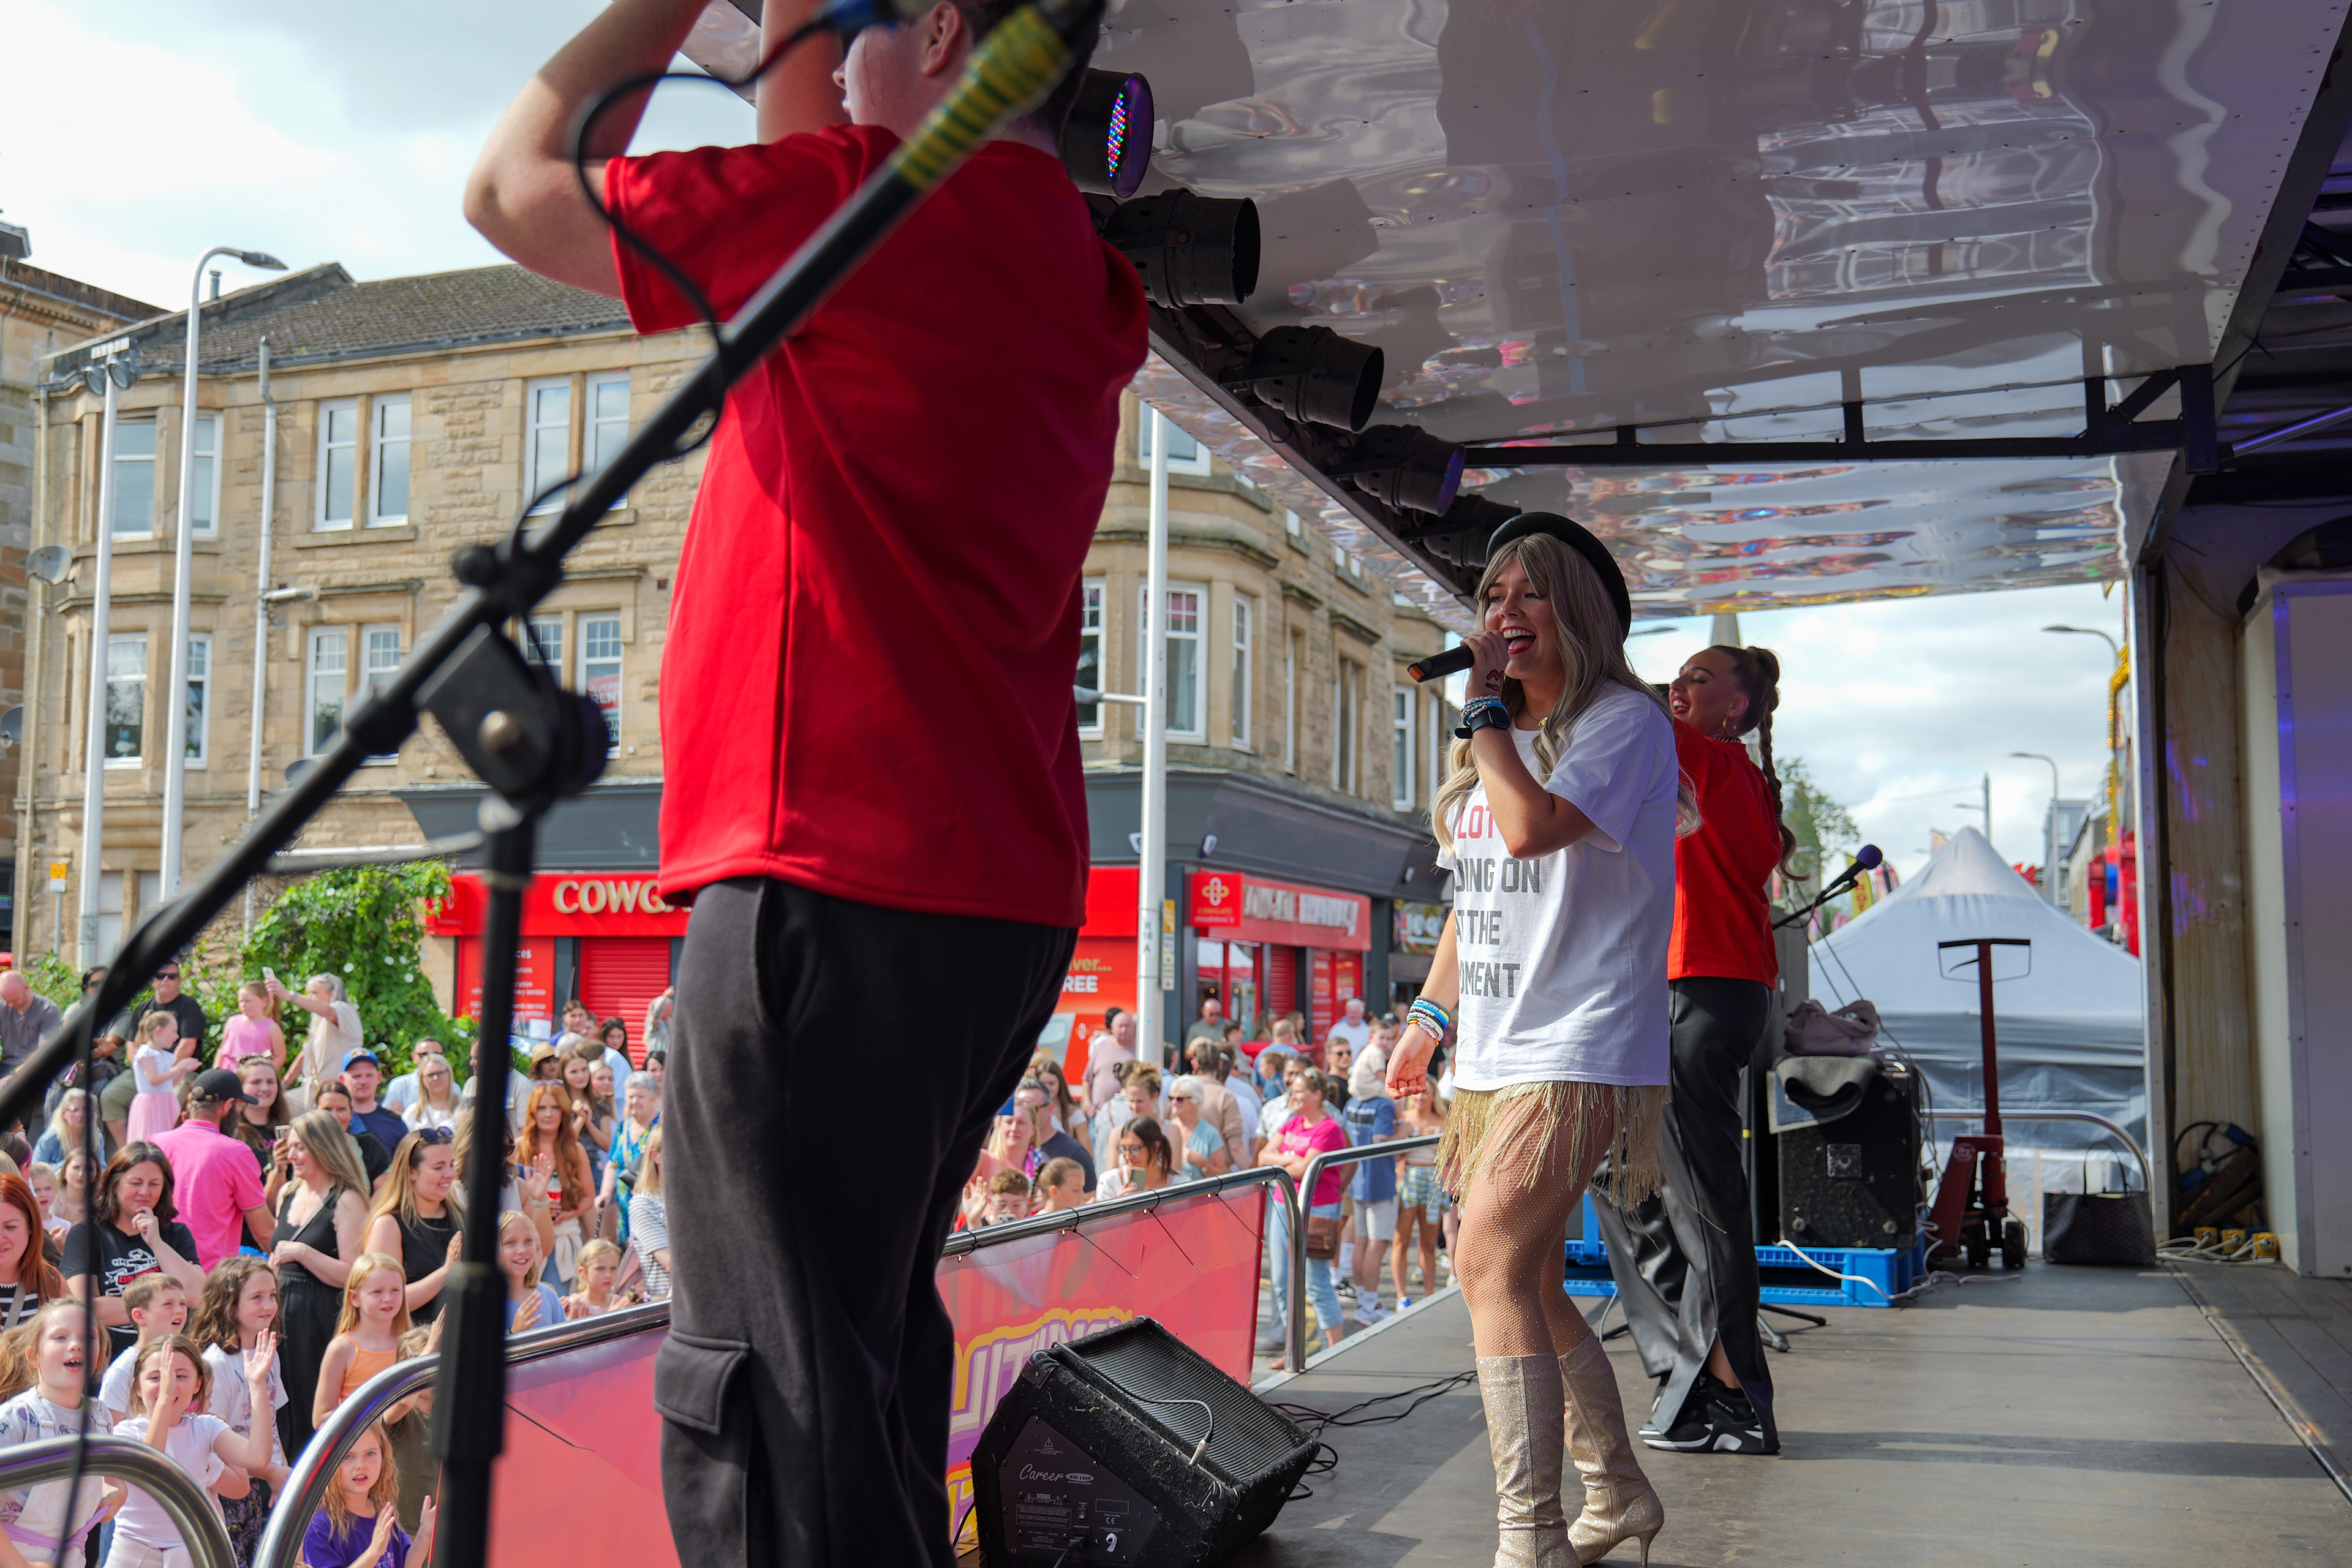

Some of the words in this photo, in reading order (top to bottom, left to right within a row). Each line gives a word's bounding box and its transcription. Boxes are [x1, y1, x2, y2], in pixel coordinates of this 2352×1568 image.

[1458, 805, 1493, 839] LOT
[1454, 858, 1495, 892] OING
[1501, 858, 1540, 893] ON
[554, 880, 692, 914] COWG
[1467, 910, 1502, 945] THE
[1062, 975, 1098, 993] REE
[1460, 960, 1520, 997] OMENT
[1019, 1463, 1065, 1482] Career
